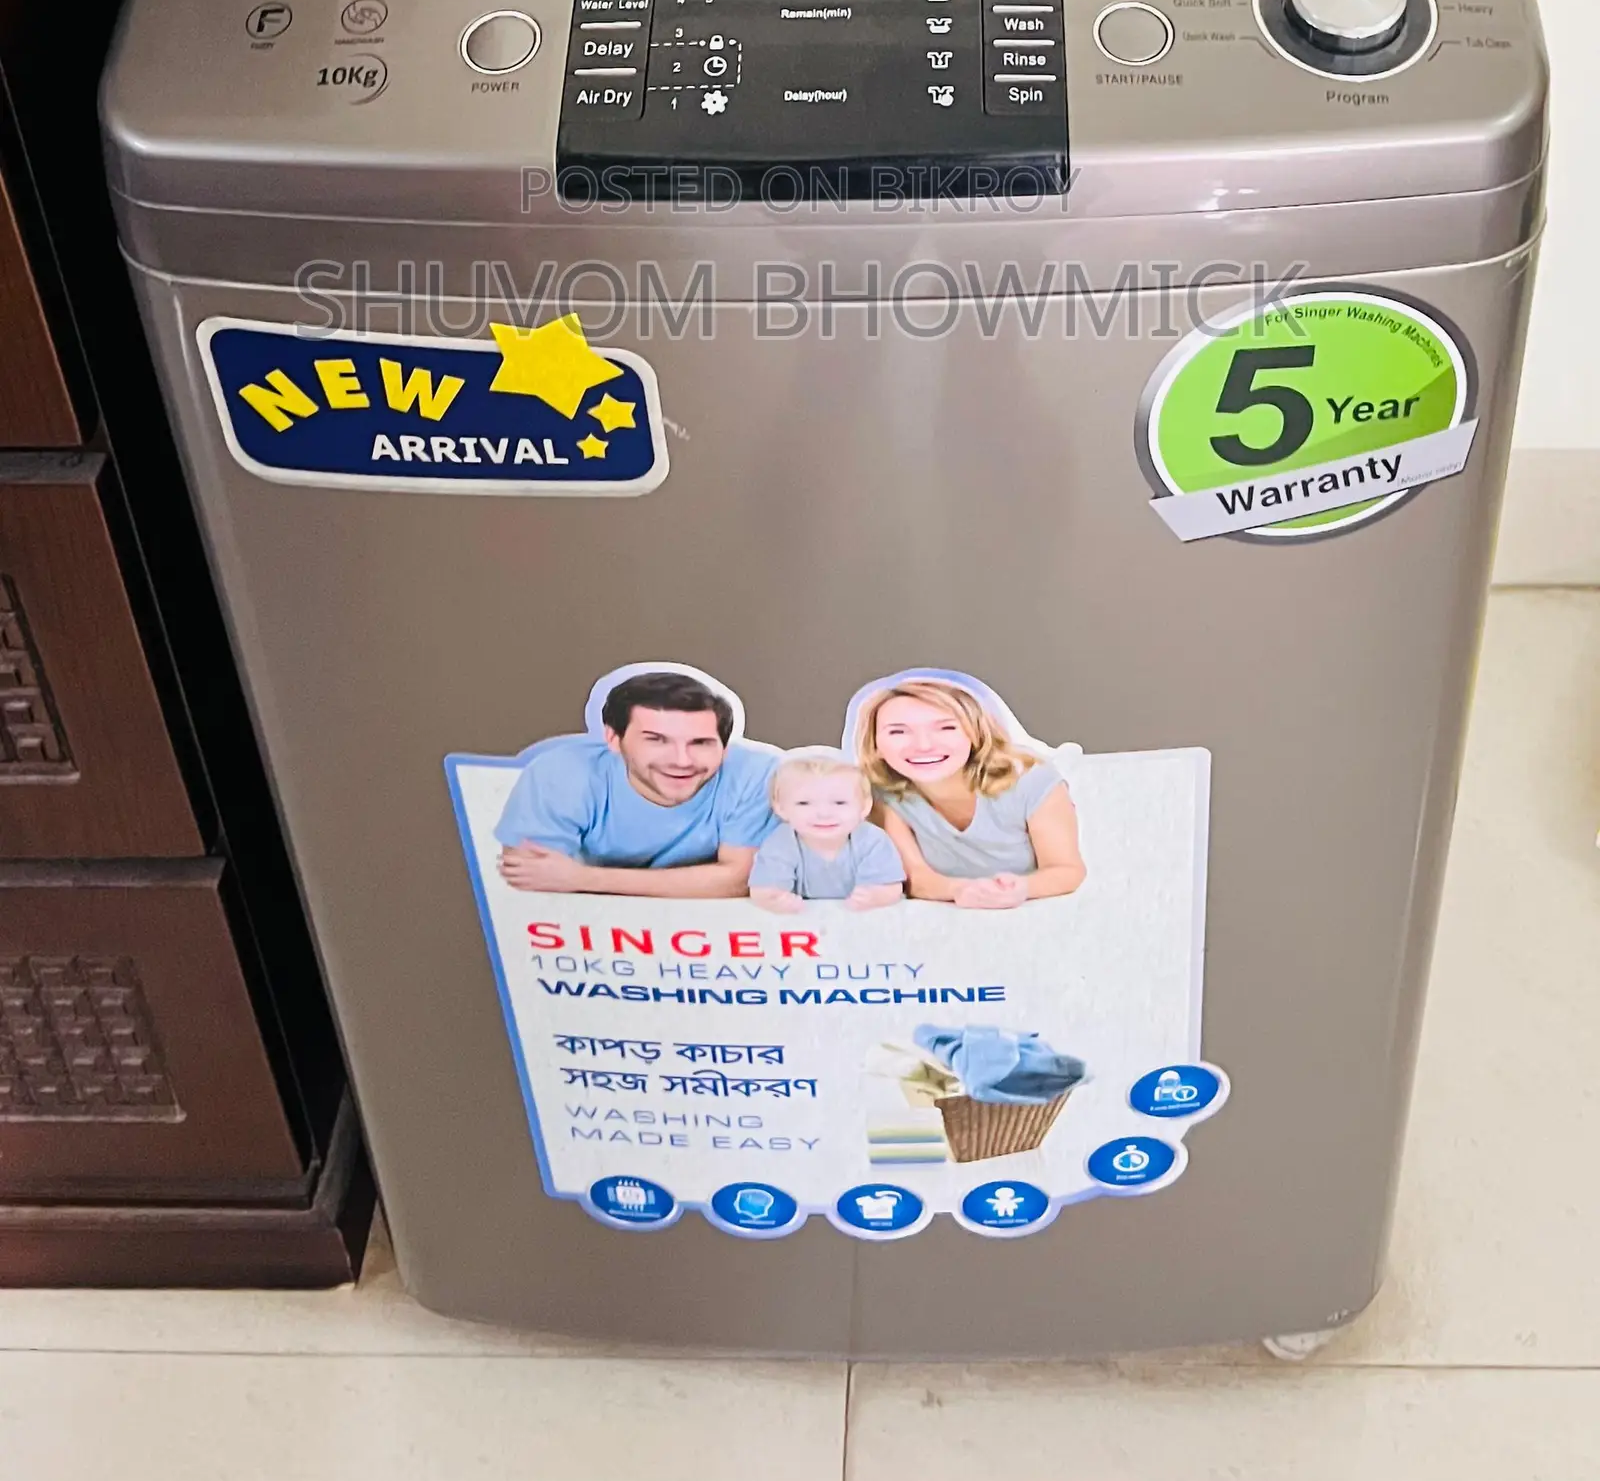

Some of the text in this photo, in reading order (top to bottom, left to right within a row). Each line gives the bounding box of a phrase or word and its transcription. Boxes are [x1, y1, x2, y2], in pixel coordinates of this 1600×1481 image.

[580, 0, 613, 11] Water
[675, 27, 684, 38] 3
[1004, 17, 1044, 31] Wash
[583, 41, 634, 59] Delay
[1003, 51, 1047, 66] Rinse
[316, 65, 379, 88] 10Kg
[672, 62, 681, 73] 2
[471, 81, 520, 93] POWER
[1095, 73, 1184, 86] START/PAUSE
[576, 89, 632, 107] Air Dry
[670, 97, 678, 110] 1
[784, 88, 847, 102] Delay(hour)
[1008, 86, 1043, 105] Spin
[1325, 90, 1390, 106] Program
[1264, 311, 1290, 326] For
[1294, 306, 1343, 320] Singer
[1346, 306, 1402, 333] Washing
[238, 357, 465, 432] NEW
[1209, 344, 1420, 466] 5 Year
[371, 434, 570, 465] ARRIVAL
[1216, 453, 1402, 516] Warranty
[527, 922, 822, 958] SINGER
[532, 955, 925, 981] 10KG HEAVY DUTY
[537, 978, 1006, 1005] WASHING MACHINE
[553, 1033, 785, 1066] কাপড় কাচার
[560, 1067, 818, 1099] সহজ সমীকরণ
[565, 1105, 763, 1129] WASHING
[571, 1127, 822, 1152] MADE EASY
